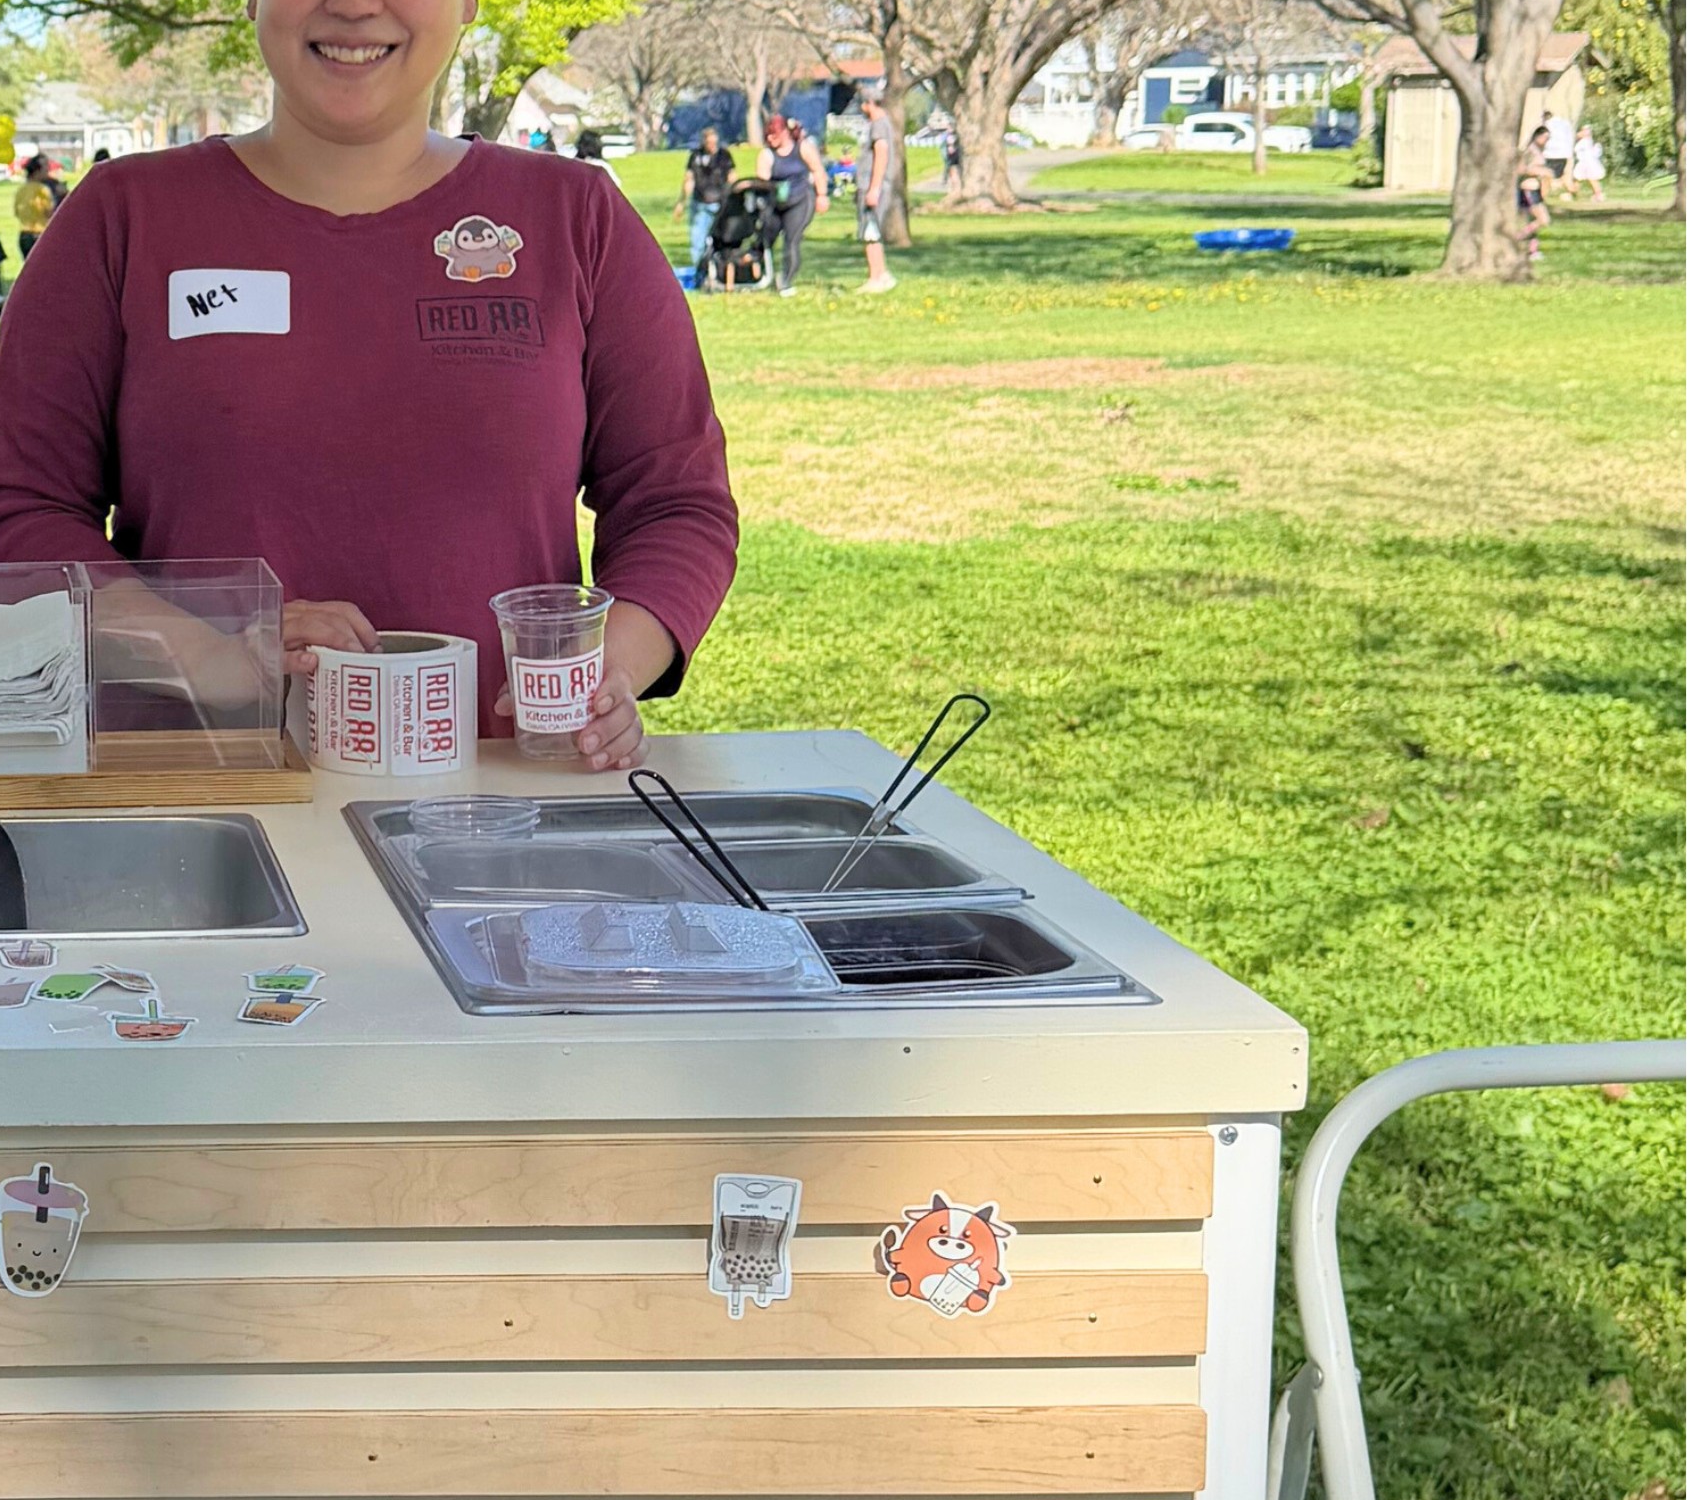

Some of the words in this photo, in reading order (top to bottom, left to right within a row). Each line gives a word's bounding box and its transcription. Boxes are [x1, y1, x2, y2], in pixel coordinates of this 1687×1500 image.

[186, 284, 238, 317] Net
[428, 305, 478, 332] RED
[488, 302, 531, 335] 88
[432, 344, 493, 356] Kitchen
[348, 673, 372, 711] RED
[403, 676, 413, 722] Kitchen
[427, 673, 449, 711] RED
[523, 673, 561, 699] RED
[525, 709, 572, 722] Kitchen
[345, 719, 375, 754] 88
[403, 736, 414, 756] Bar
[423, 718, 453, 753] 88
